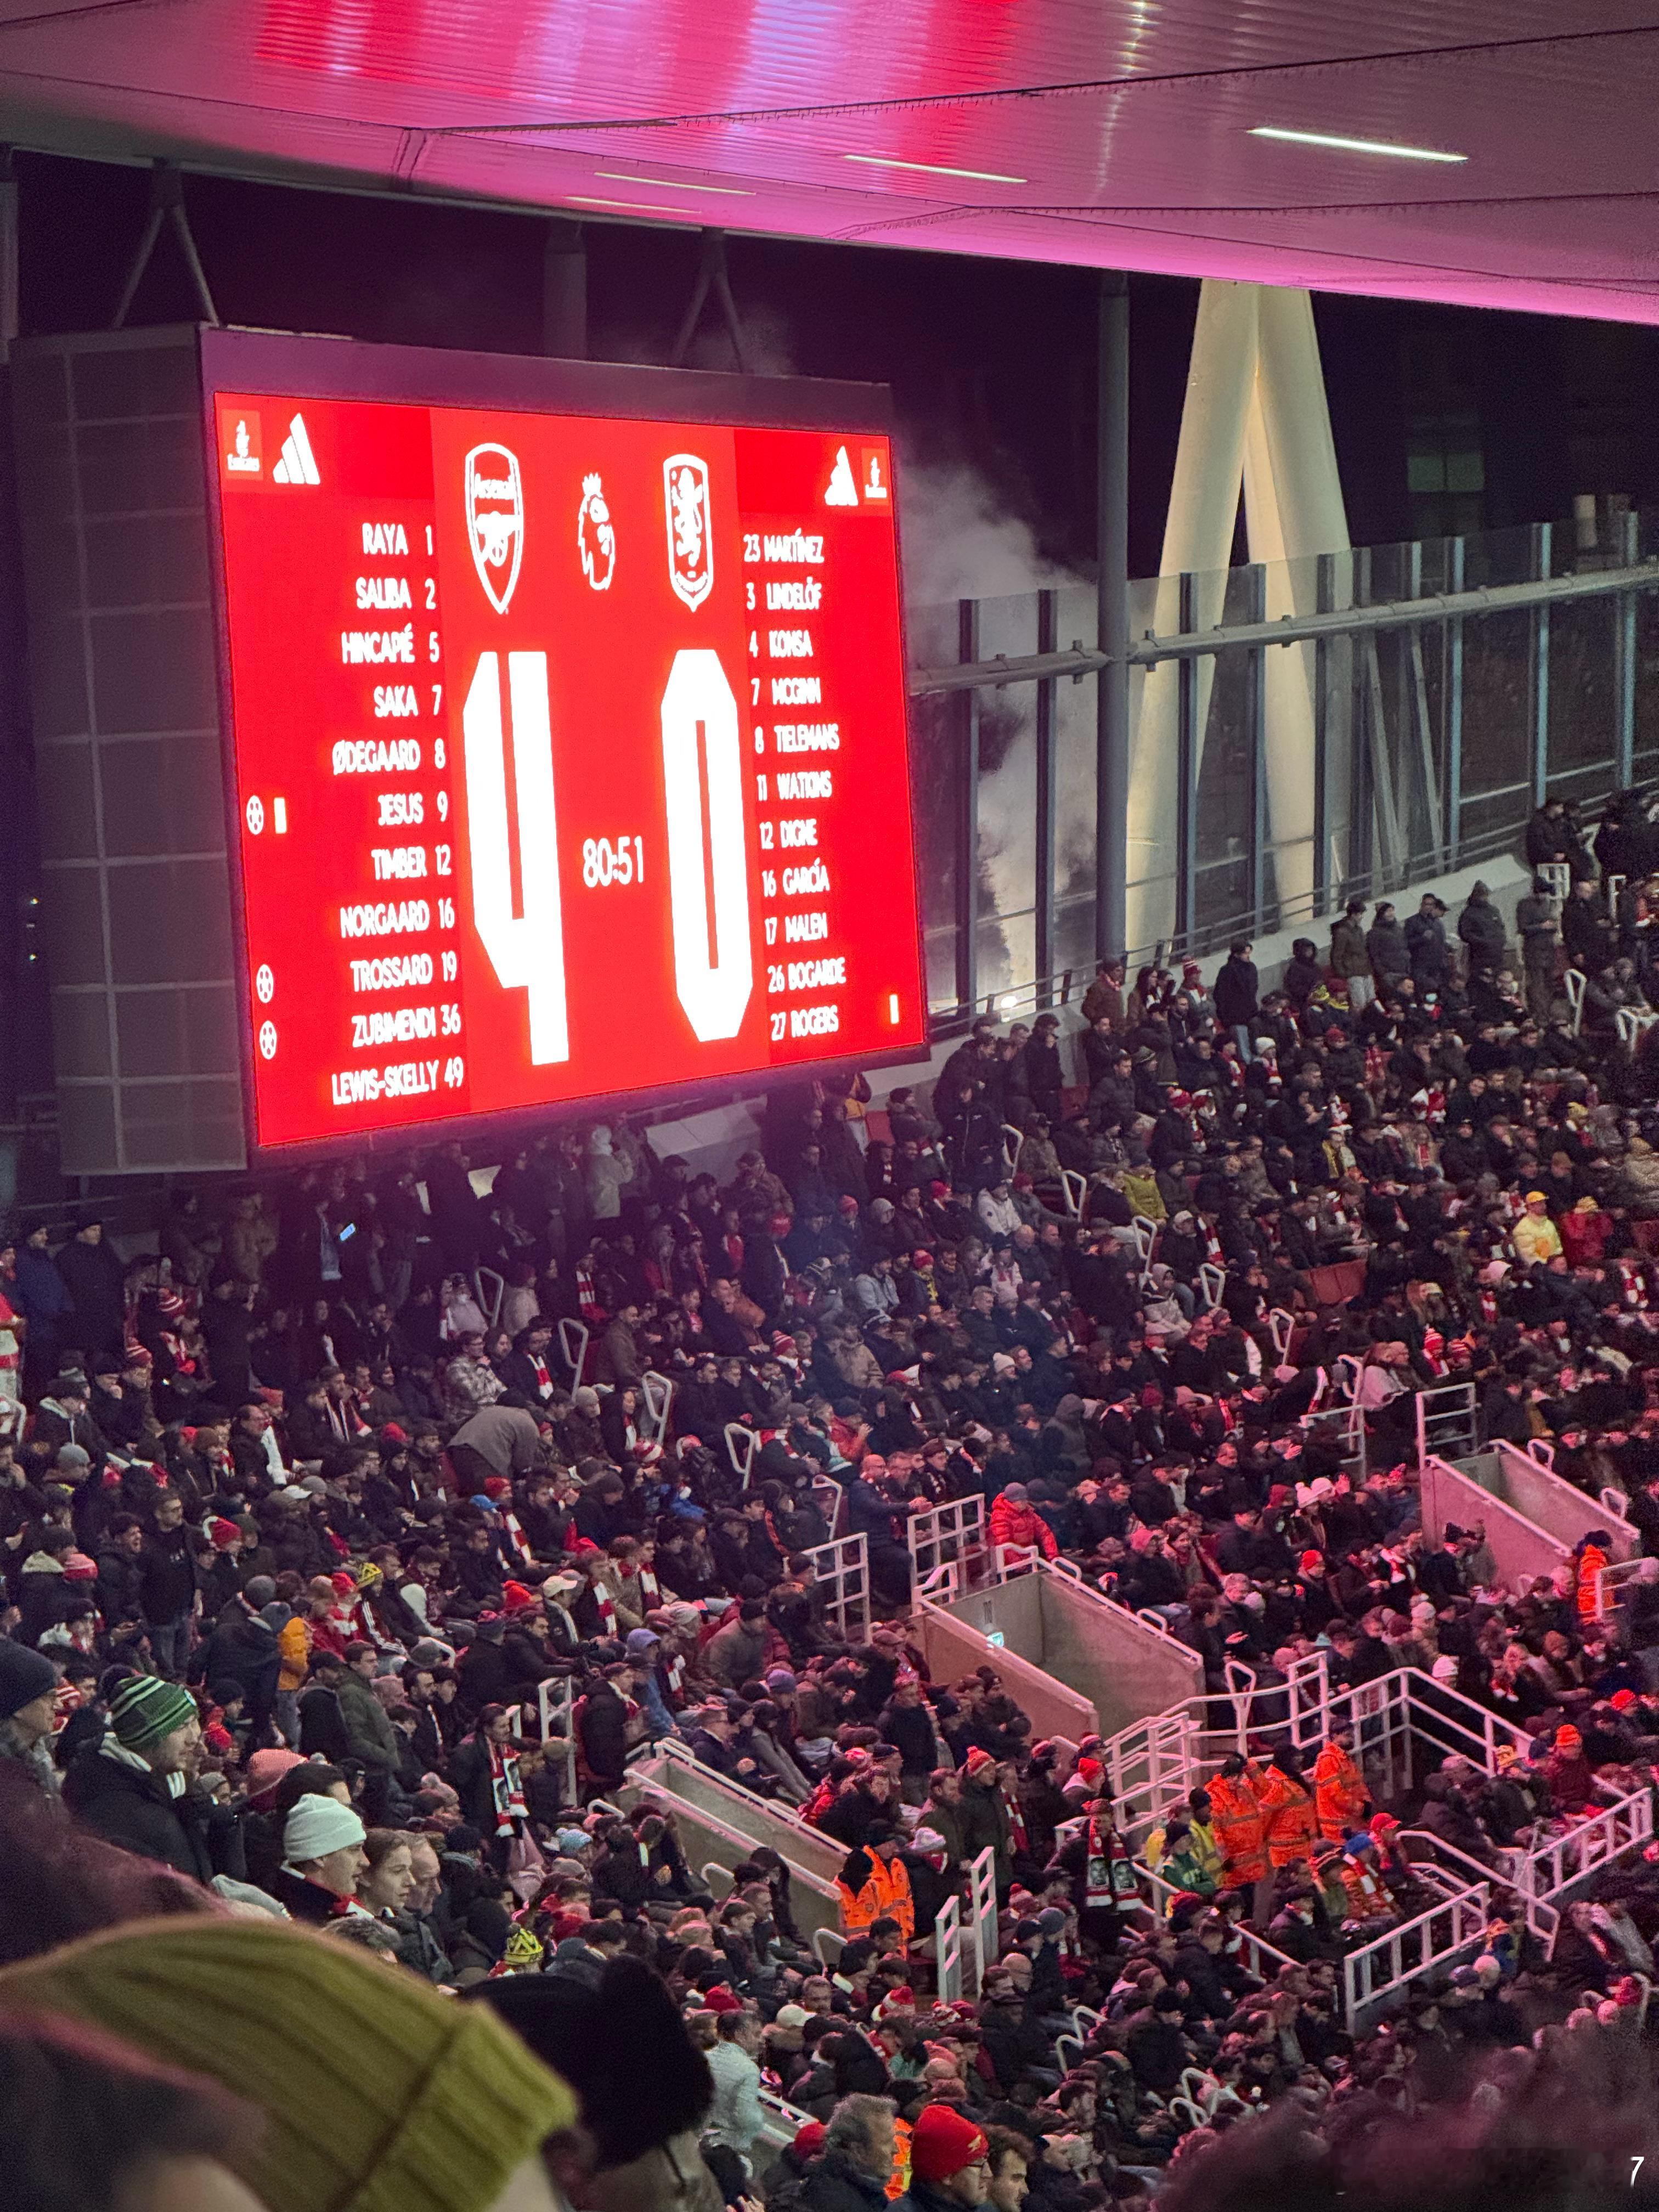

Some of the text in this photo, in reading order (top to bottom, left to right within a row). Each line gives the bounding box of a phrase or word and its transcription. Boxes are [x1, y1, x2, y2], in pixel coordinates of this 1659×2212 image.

[363, 523, 432, 555] RAYA 1
[743, 528, 824, 563] 23 MARTÍNEZ
[356, 577, 436, 609] SALIBA 2
[747, 583, 755, 610] 3
[430, 632, 439, 662] 5
[749, 630, 813, 657] 4 KONSA
[374, 685, 441, 717] SAKA 7
[751, 678, 759, 706] 7
[332, 738, 445, 775] ØDEGAARD 8
[755, 724, 839, 754] 8 TIELEMANS
[757, 775, 767, 801] 11
[378, 791, 448, 826] JESUS 9
[661, 650, 753, 1042] 0
[760, 819, 817, 849] 12 DIGNE
[371, 844, 451, 880] TIMBER 12
[462, 652, 569, 1065] 4
[583, 836, 643, 888] 80:51
[762, 857, 830, 897] 16 GARCÍA
[340, 898, 454, 938] NORGAARD 16
[765, 913, 827, 945] 17 MALEN
[350, 951, 456, 992] TROSSARD 19
[768, 957, 846, 992] 26 BOGARDE
[352, 1004, 461, 1047] ZUBIMENDI 36
[771, 1005, 838, 1041] 27 ROGERS
[332, 1057, 463, 1105] LEWIS-SKELLY 49
